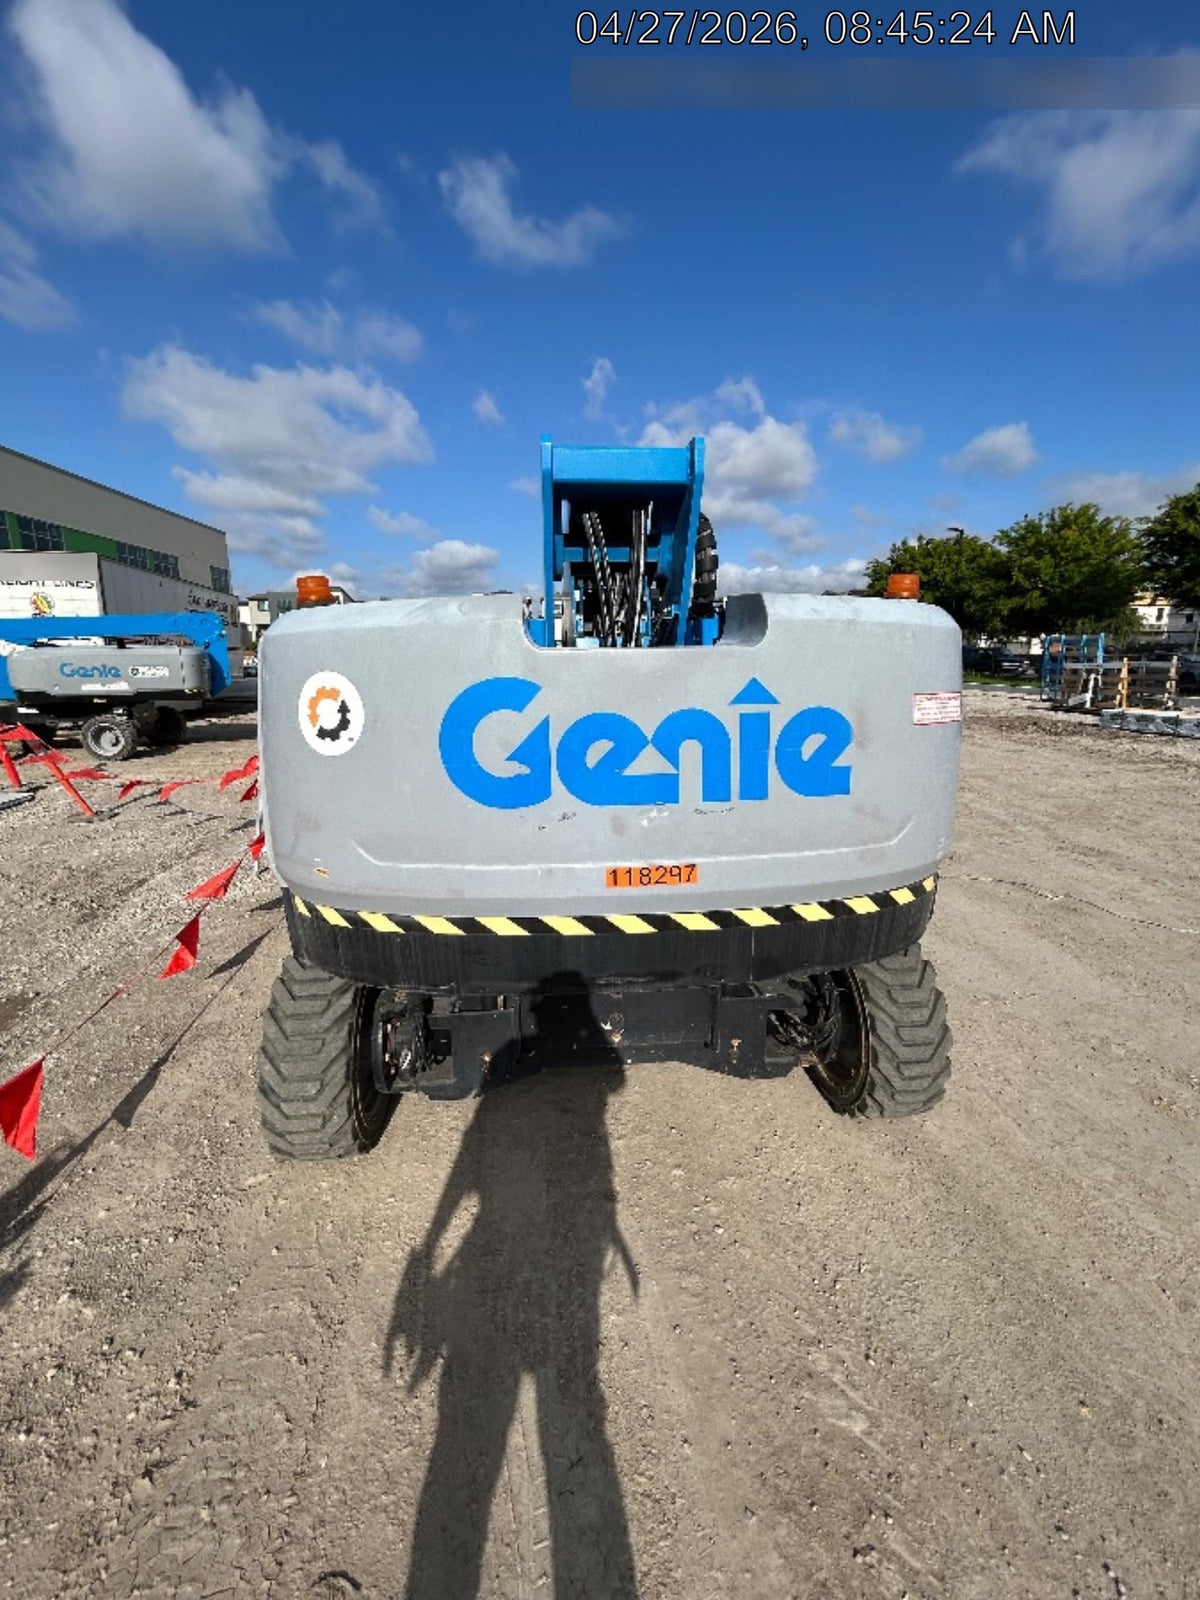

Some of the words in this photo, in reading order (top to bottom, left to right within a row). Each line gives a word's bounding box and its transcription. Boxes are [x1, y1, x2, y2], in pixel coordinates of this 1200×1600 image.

[60, 662, 121, 678] Genie
[438, 677, 853, 809] Genie
[609, 863, 697, 886] 118297
